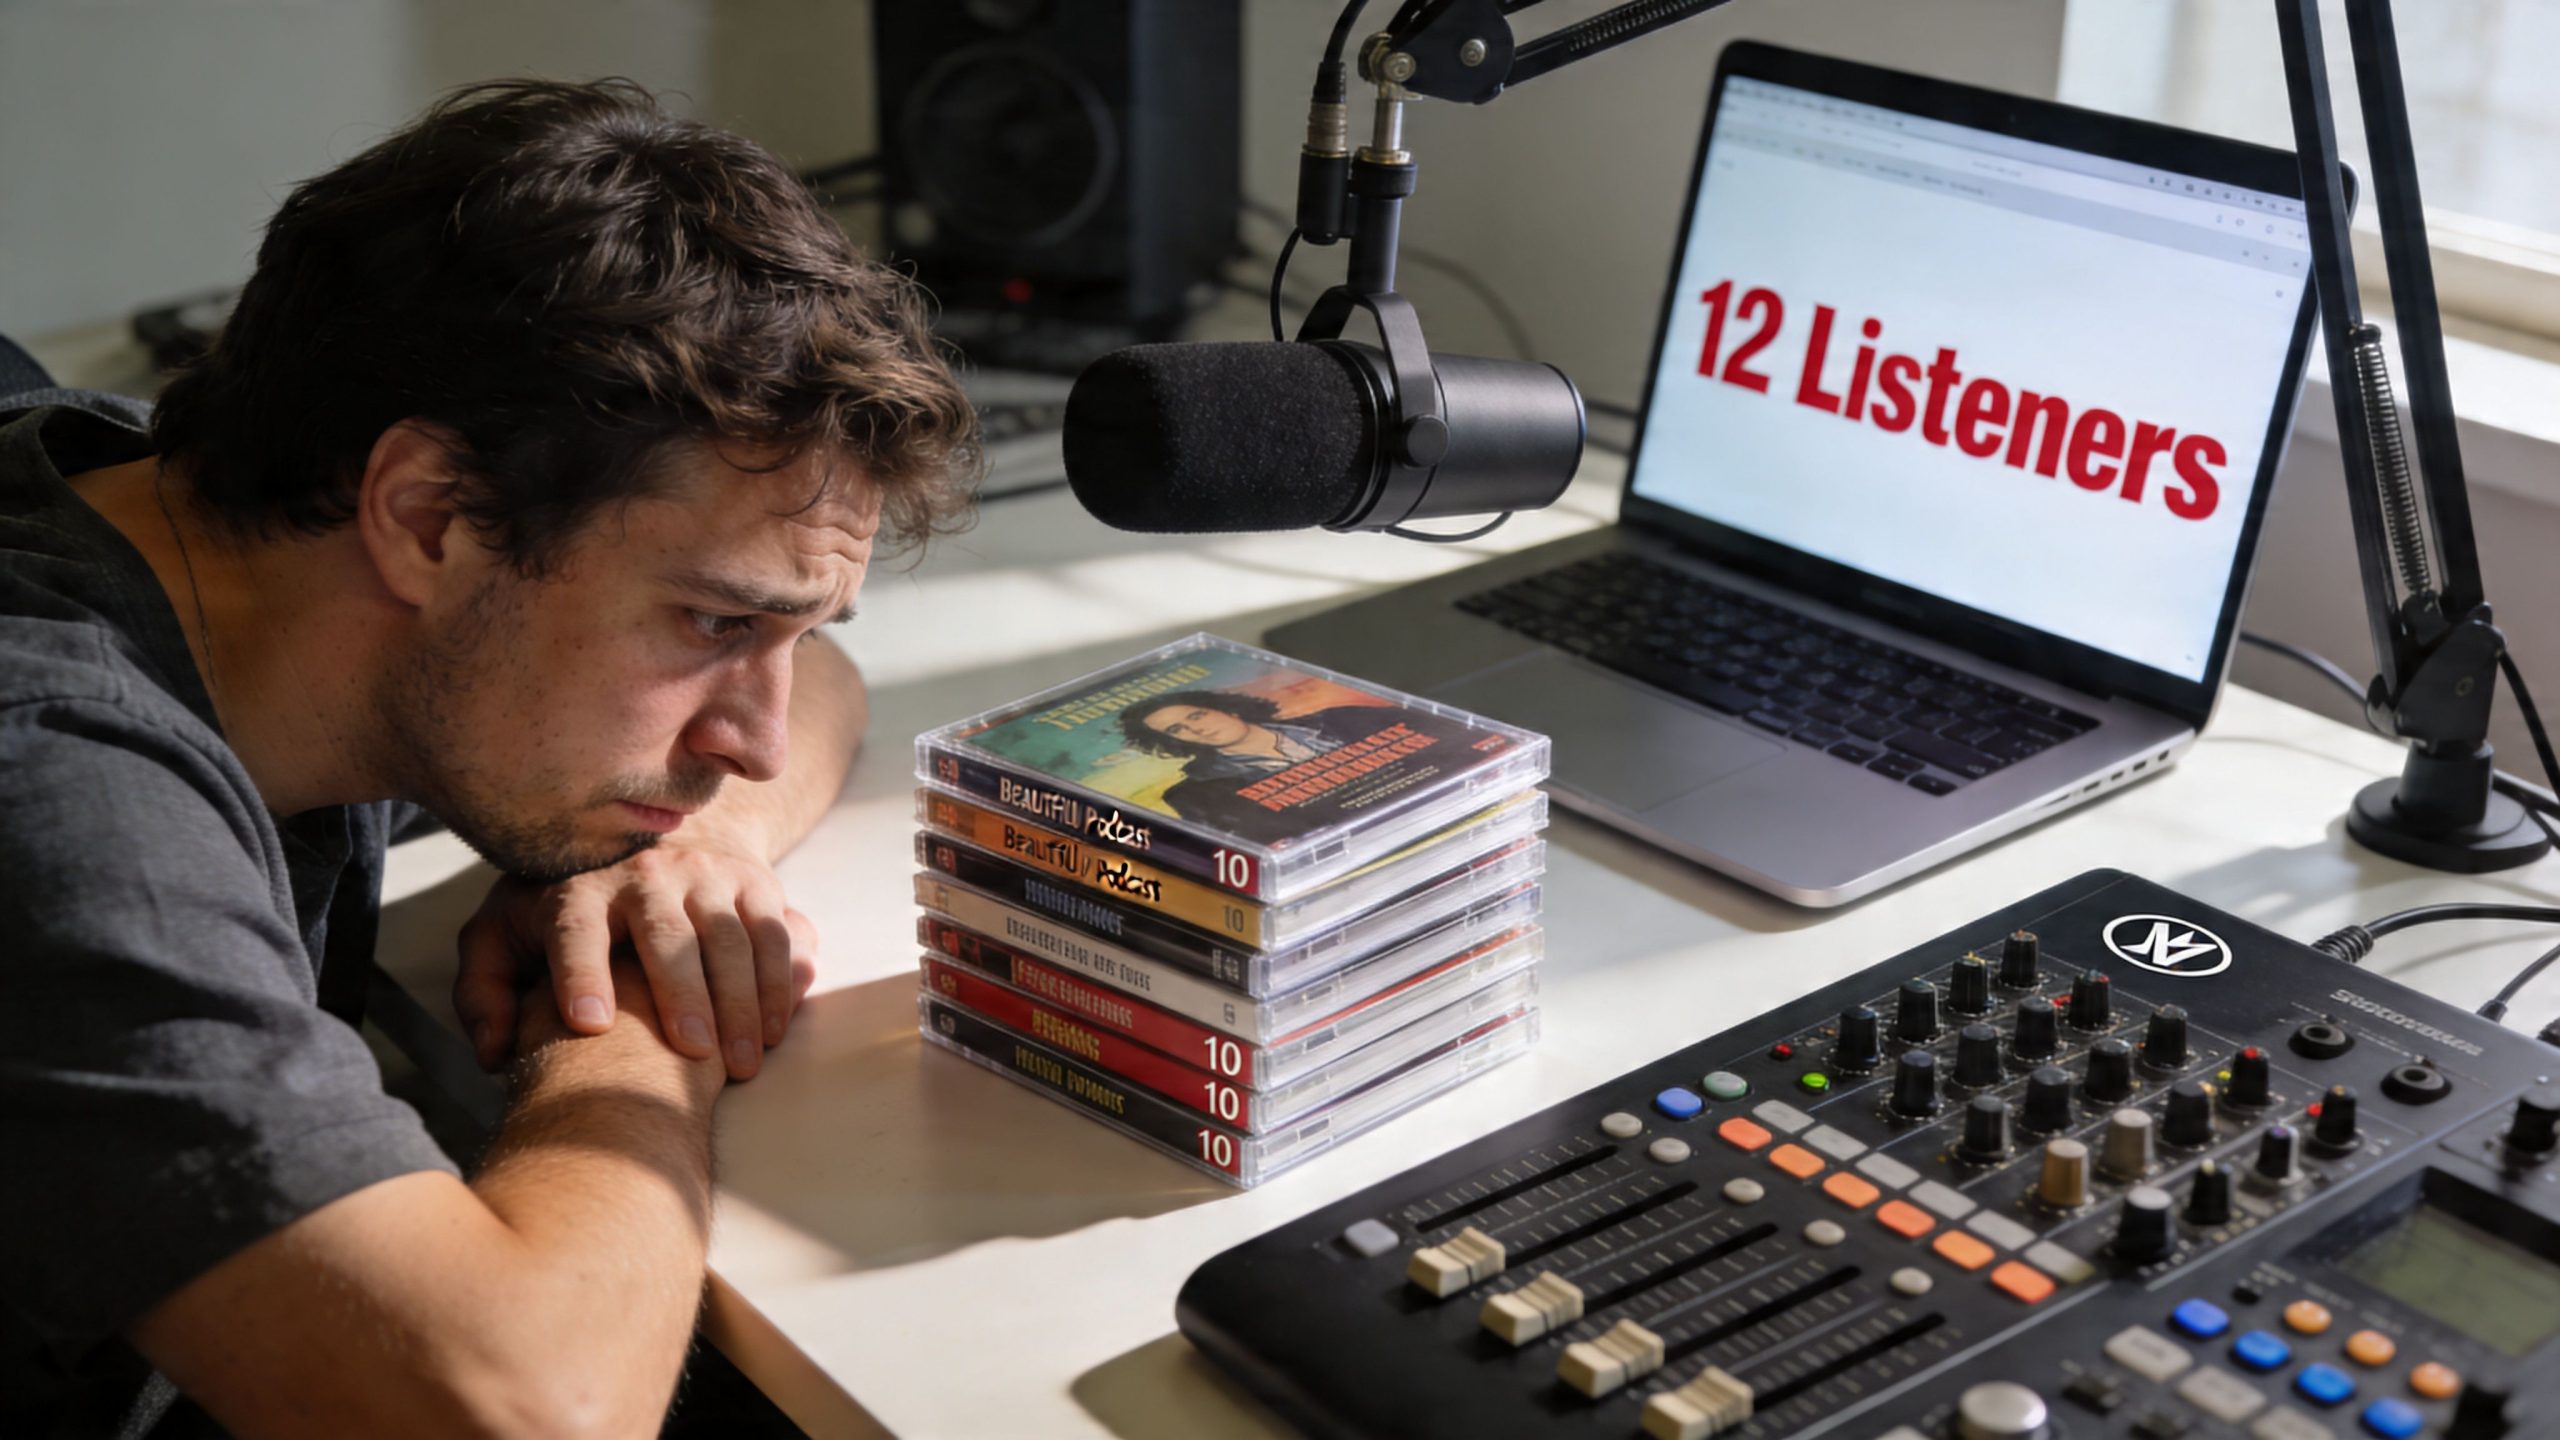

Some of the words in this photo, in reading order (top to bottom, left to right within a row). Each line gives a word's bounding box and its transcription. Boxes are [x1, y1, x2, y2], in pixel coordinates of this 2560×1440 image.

[1697, 279, 1785, 395] 12
[1795, 304, 2228, 522] Listeners
[1213, 848, 1250, 889] 10
[1204, 1036, 1242, 1076] 10
[1204, 1081, 1240, 1121] 10
[1199, 1129, 1232, 1167] 10
